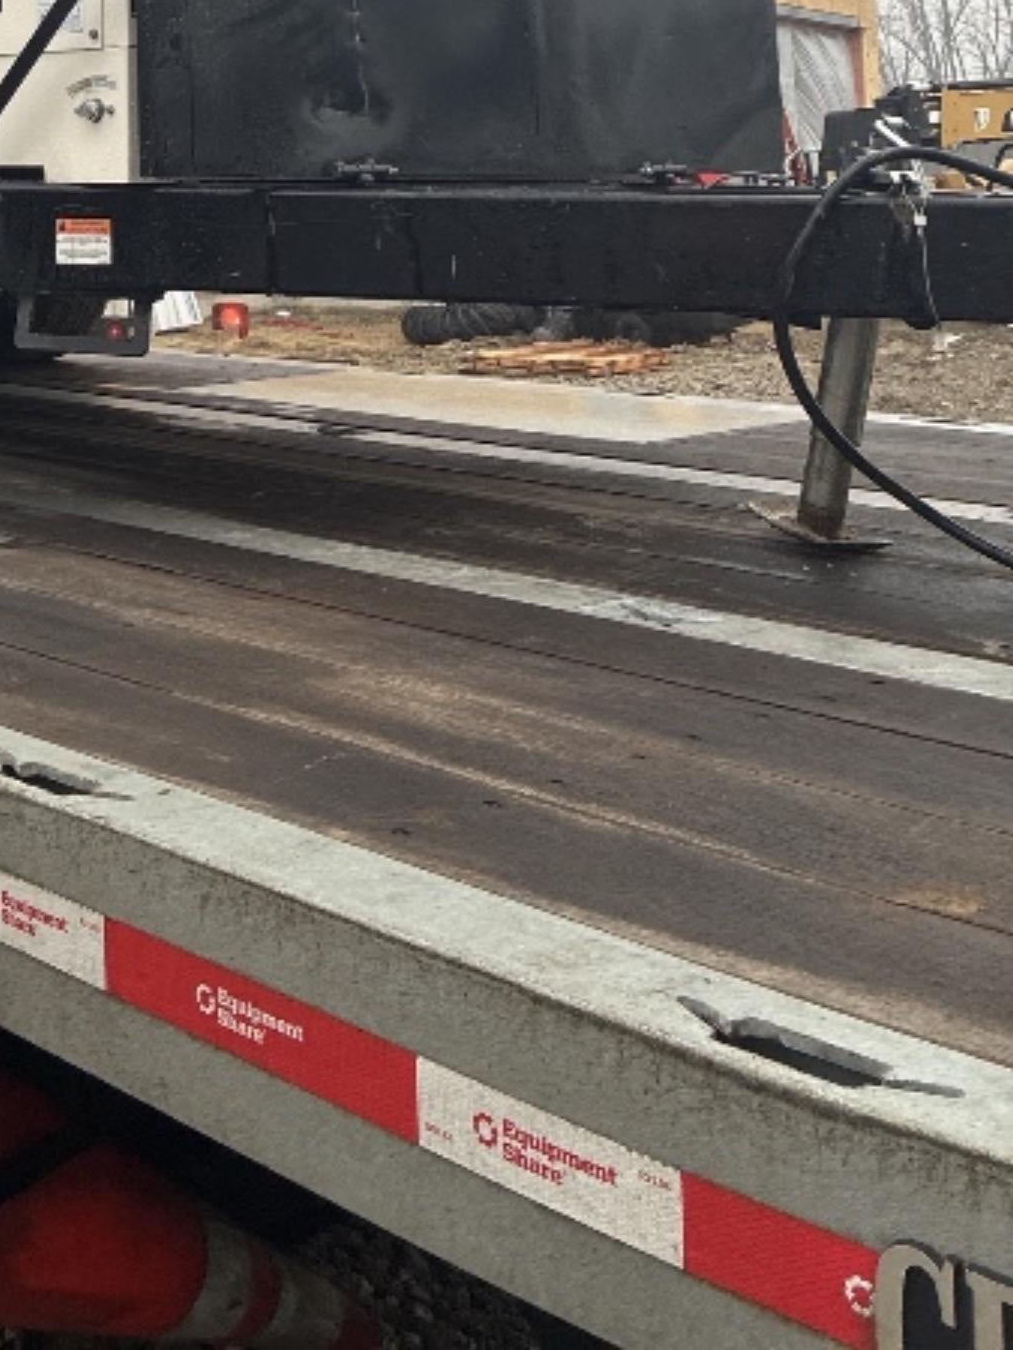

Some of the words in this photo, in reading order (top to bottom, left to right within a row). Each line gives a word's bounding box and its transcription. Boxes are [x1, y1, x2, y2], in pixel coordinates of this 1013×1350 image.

[217, 987, 304, 1042] Equipment
[217, 1008, 264, 1044] Share
[503, 1119, 617, 1187] Equipment
[503, 1143, 563, 1185] Share
